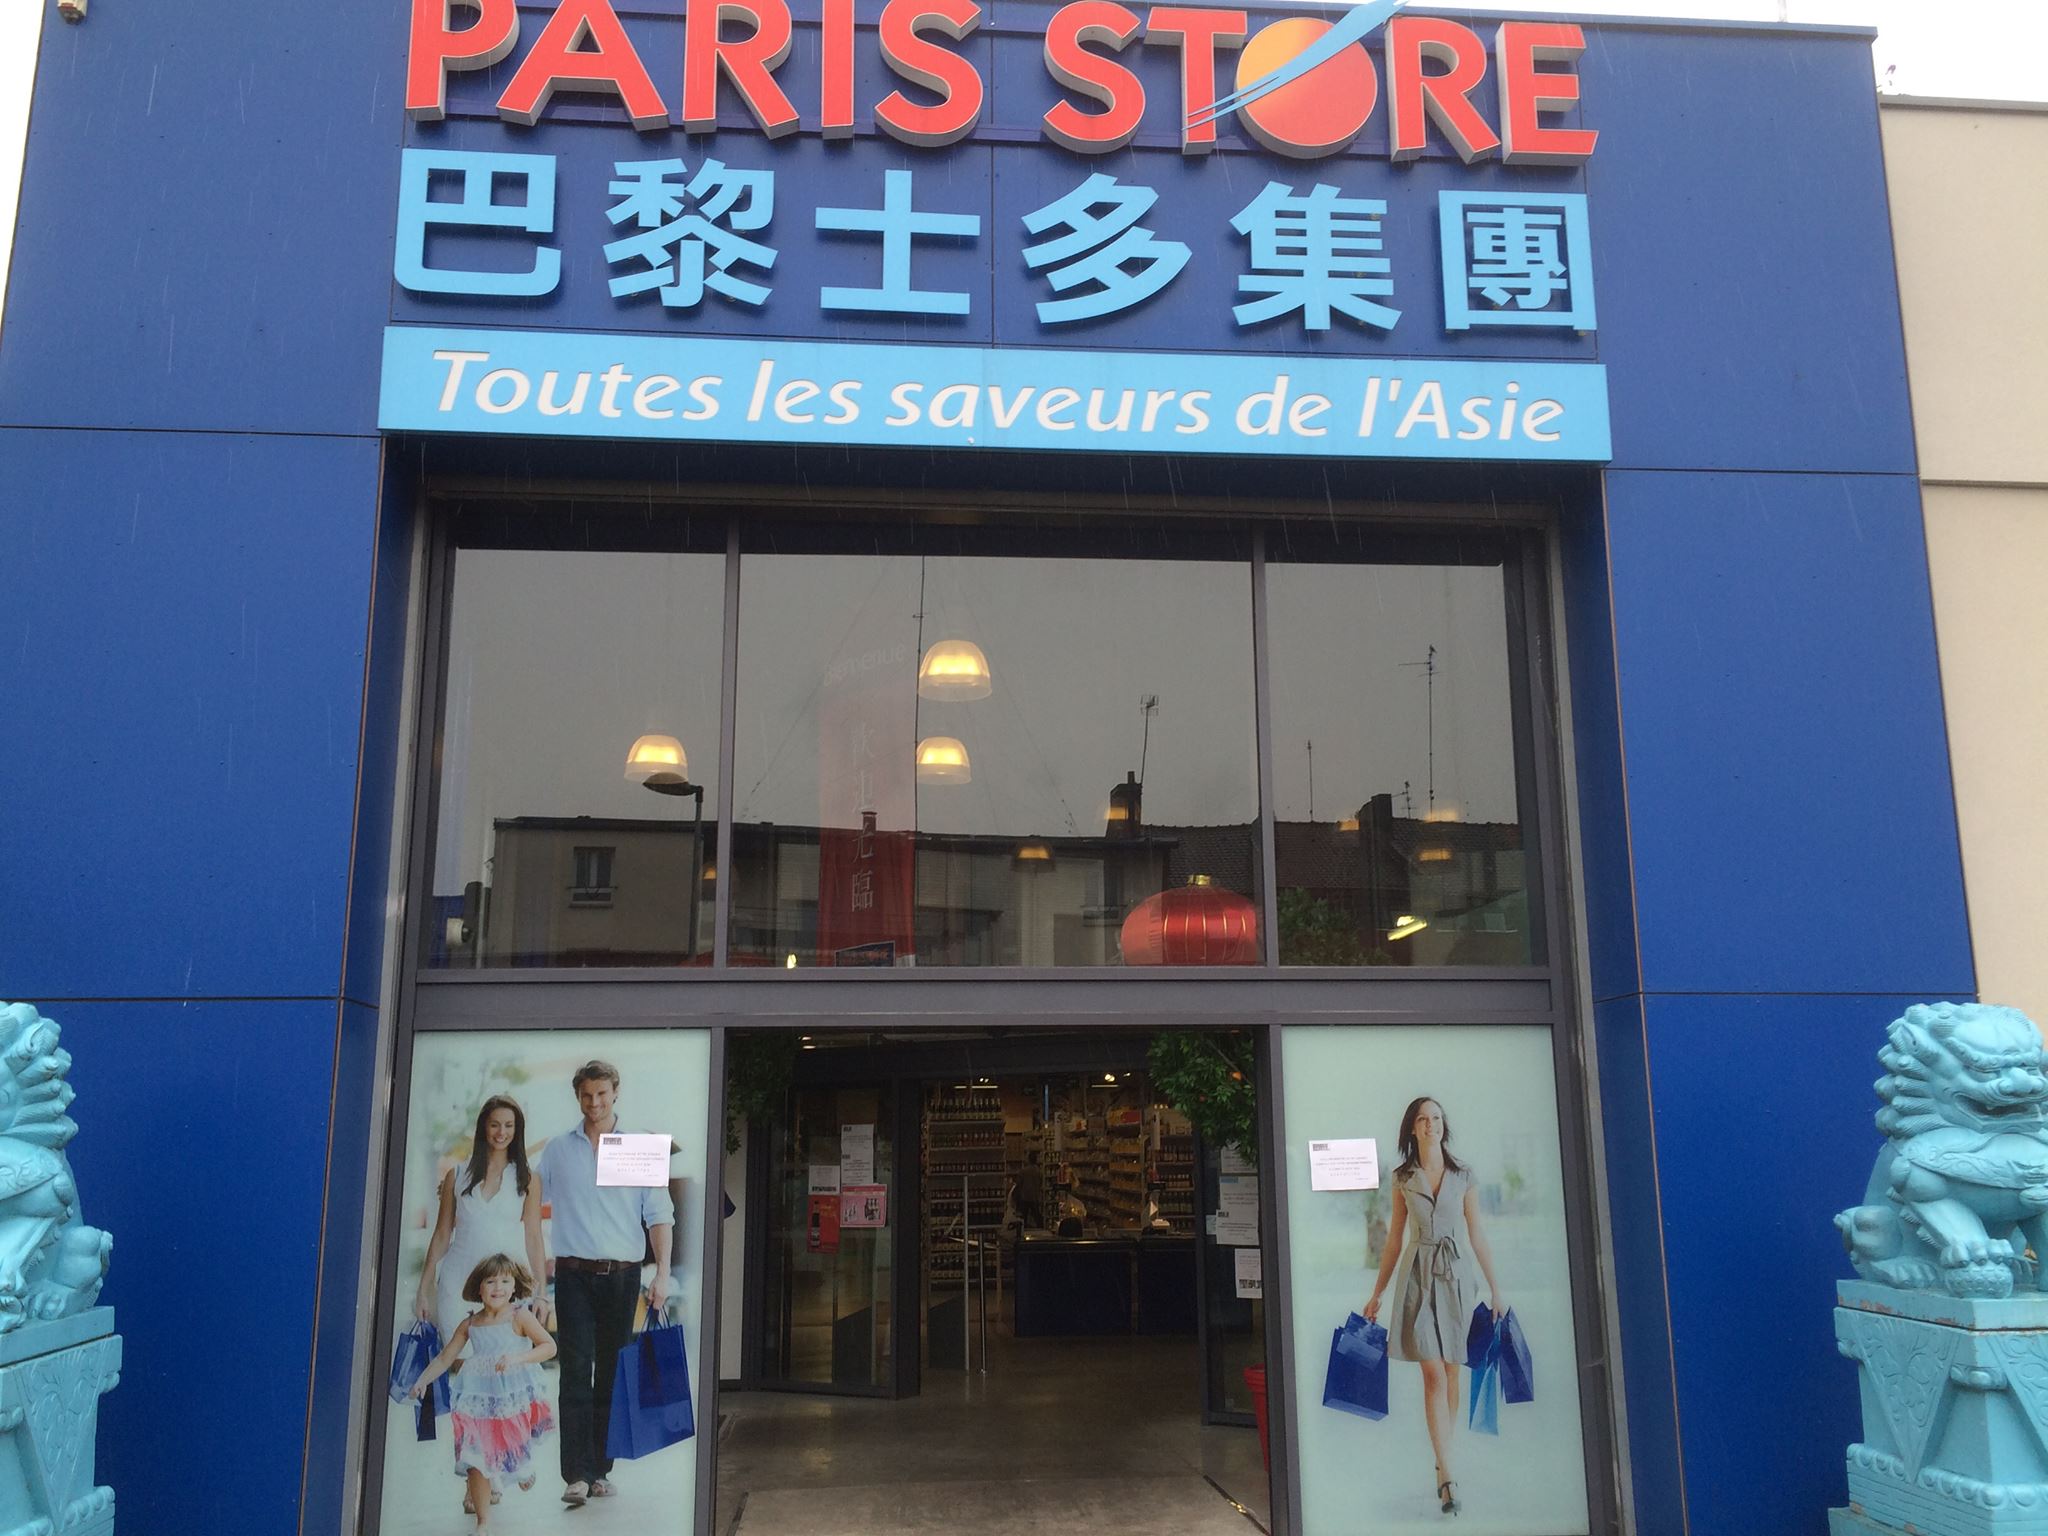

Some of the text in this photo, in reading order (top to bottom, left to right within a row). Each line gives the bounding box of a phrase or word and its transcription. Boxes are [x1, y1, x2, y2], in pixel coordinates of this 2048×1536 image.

[404, 0, 1601, 165] PARIS STORE
[394, 147, 1597, 332] 巴黎士多集團
[432, 349, 1565, 442] Toutes les saveurs de l'Asie
